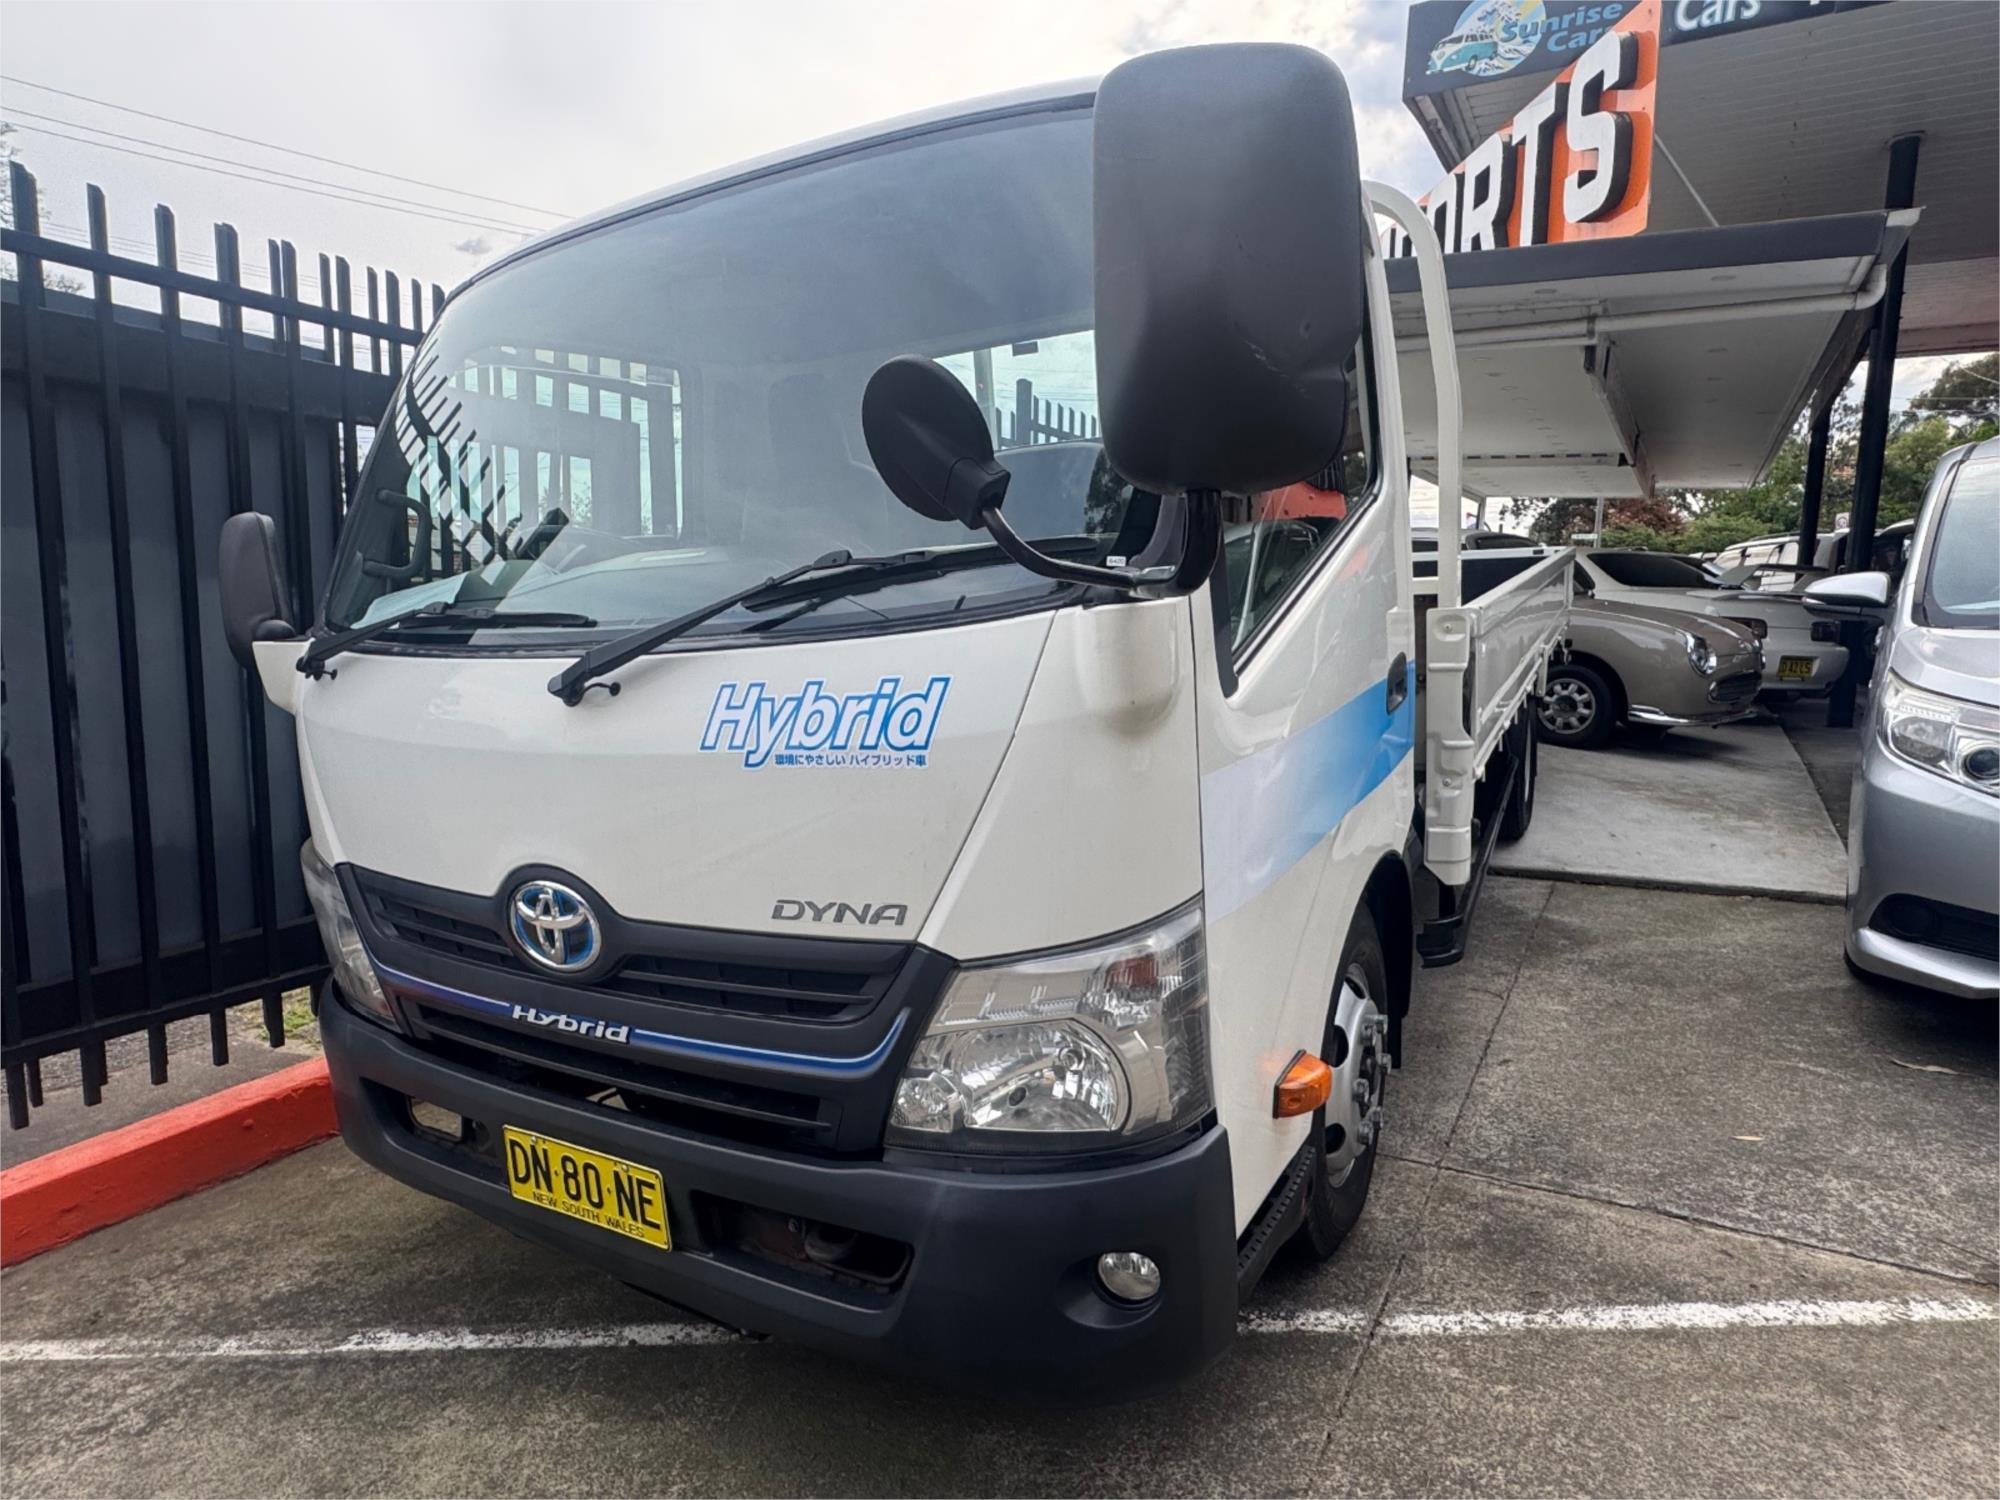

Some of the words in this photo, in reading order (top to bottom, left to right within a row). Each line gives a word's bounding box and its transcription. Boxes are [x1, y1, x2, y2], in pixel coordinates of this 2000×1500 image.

[1501, 3, 1623, 42] Sunrise
[1546, 27, 1609, 52] Car
[1382, 31, 1624, 258] ORTS
[700, 677, 950, 768] Hybrid
[774, 754, 846, 766] 環境にやさしい
[849, 754, 926, 766] ハイブリッド車
[771, 899, 908, 926] DYNA
[512, 1004, 628, 1043] Hybrid
[532, 1191, 557, 1209] NEW
[562, 1200, 600, 1222] SOUTH
[604, 1214, 645, 1238] WALES
